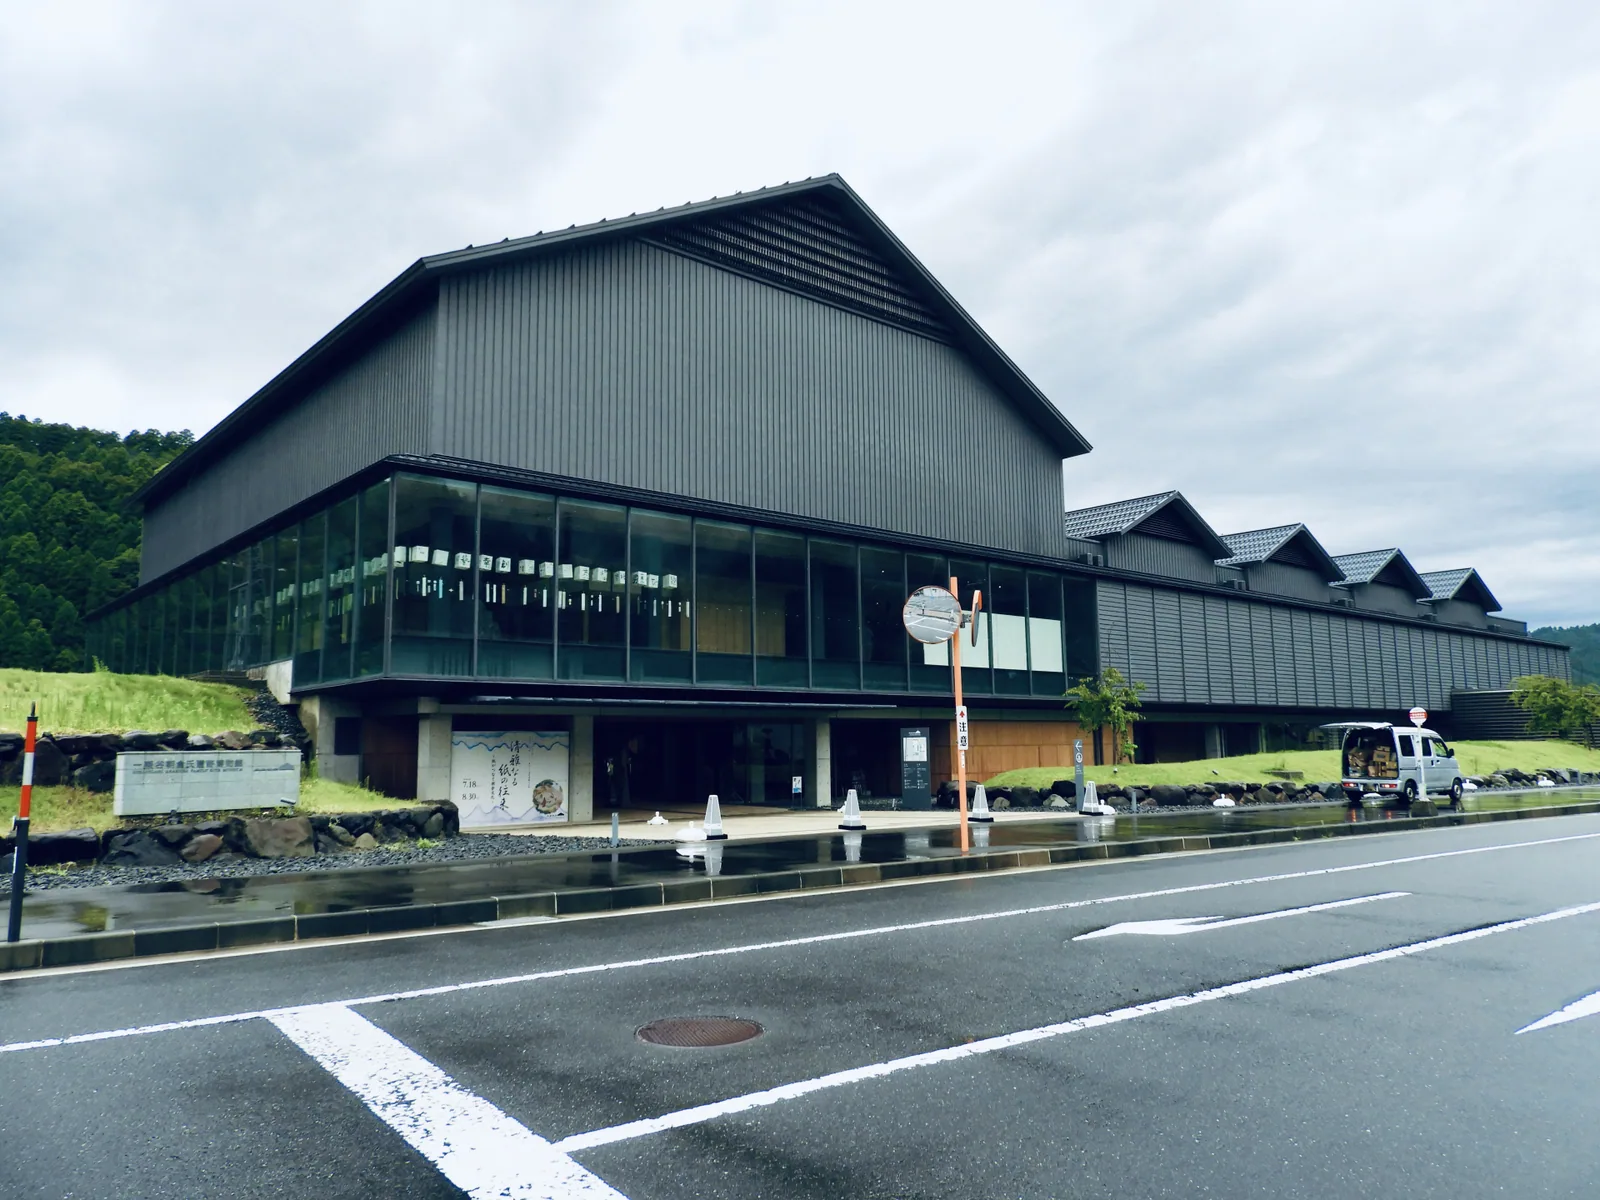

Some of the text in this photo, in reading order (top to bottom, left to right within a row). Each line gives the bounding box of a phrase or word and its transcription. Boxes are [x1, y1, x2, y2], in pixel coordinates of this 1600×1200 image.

[959, 722, 968, 747] 注意
[509, 740, 521, 786] 清雅なる
[462, 781, 477, 789] 7.18
[498, 764, 511, 811] 紙の往来
